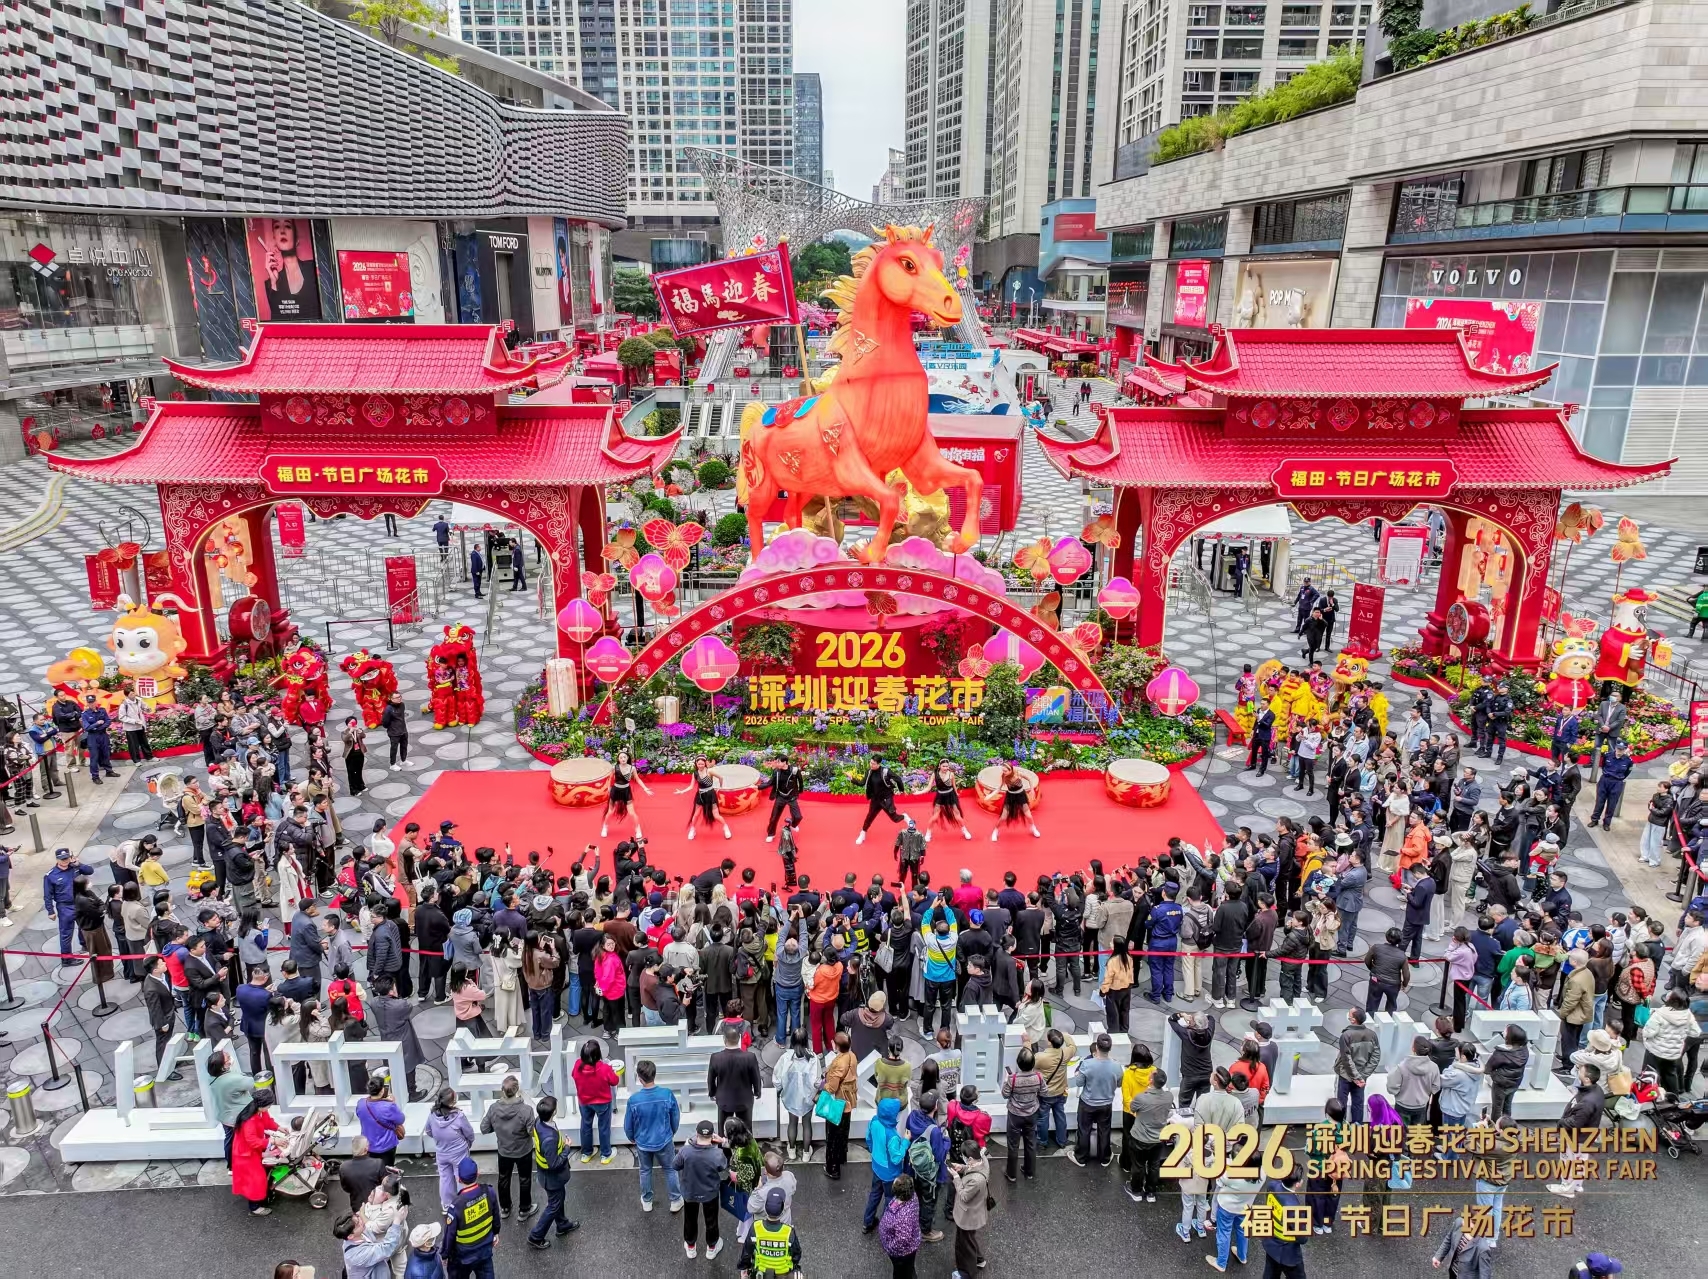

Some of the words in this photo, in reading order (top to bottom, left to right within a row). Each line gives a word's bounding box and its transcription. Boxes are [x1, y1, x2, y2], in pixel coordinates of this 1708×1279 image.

[489, 235, 503, 248] TOM
[503, 236, 519, 249] FORD
[68, 247, 151, 267] 卓悦中心
[1432, 268, 1522, 286] VOLVO
[671, 272, 779, 314] 福馬迎春
[1269, 290, 1284, 306] POP
[277, 466, 429, 484] 福田·节日广场花市
[1290, 470, 1442, 487] 福田·节日广场花市
[1358, 609, 1374, 619] 入口
[815, 632, 906, 668] 2026
[749, 674, 985, 712] 深圳迎春花市
[1070, 689, 1105, 707] 深圳
[745, 716, 769, 725] 2026
[962, 716, 984, 726] FAIR
[1067, 707, 1103, 722] 福田
[761, 1249, 784, 1257] POLICE
